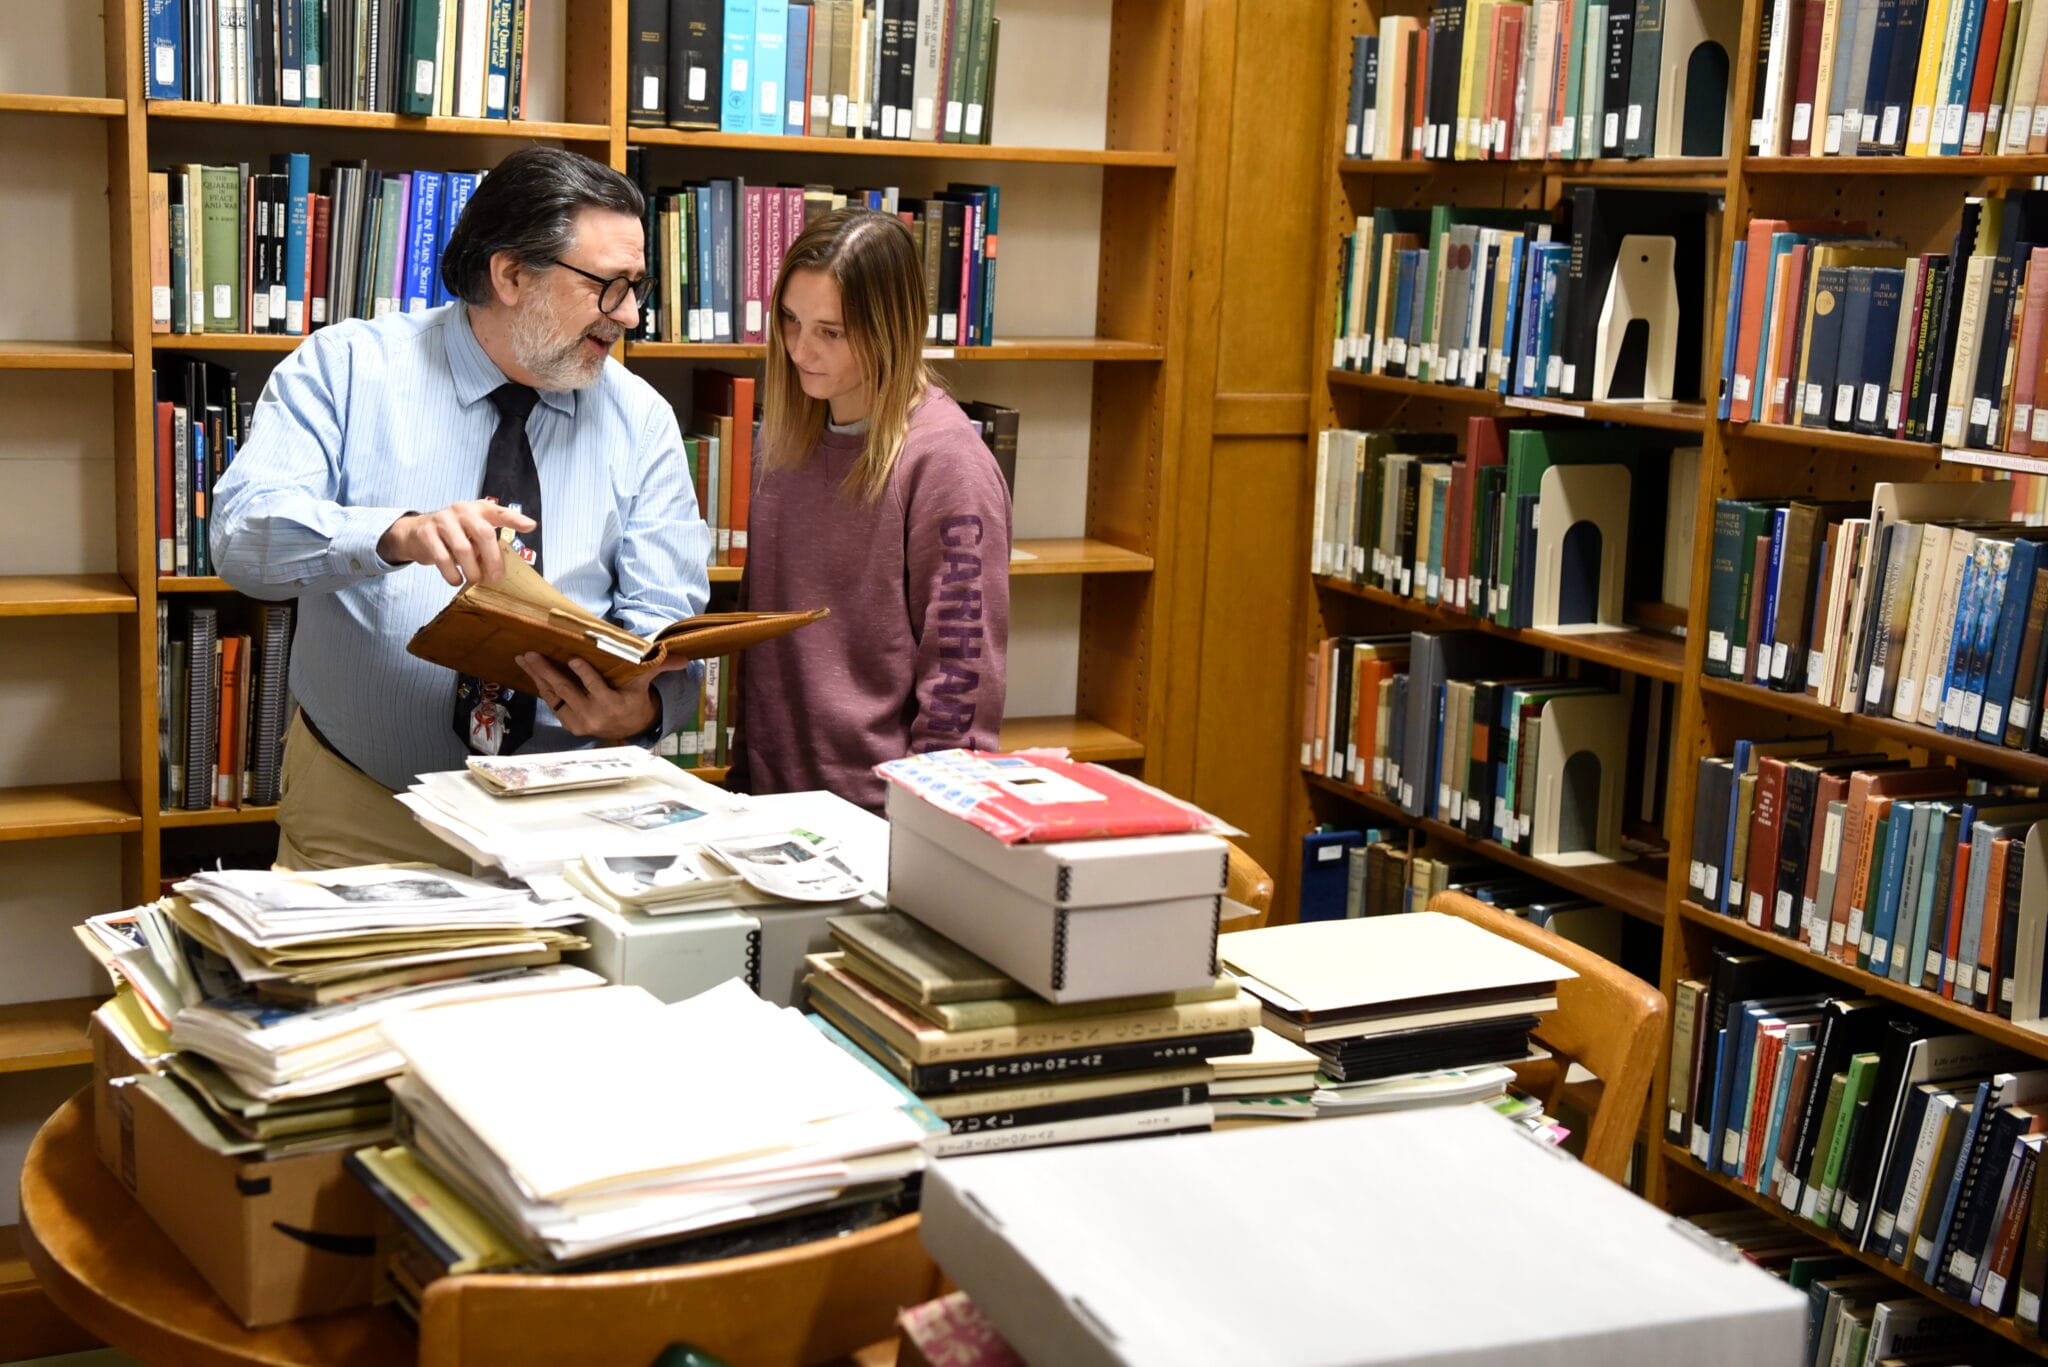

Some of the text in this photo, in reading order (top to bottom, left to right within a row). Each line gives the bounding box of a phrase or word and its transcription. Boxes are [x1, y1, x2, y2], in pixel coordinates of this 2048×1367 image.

[495, 1, 512, 69] Early Quakers
[515, 29, 523, 54] LIGHT
[1963, 22, 1973, 45] Heart
[1956, 57, 1967, 81] Things
[424, 175, 439, 216] HIDDEN
[752, 193, 760, 209] WILT
[421, 232, 434, 264] PLAIN
[419, 267, 432, 296] SIGHT
[1926, 268, 1936, 298] ESSAYS
[1964, 273, 1982, 314] While
[1918, 309, 1930, 352] GRATITUDE
[1955, 343, 1972, 371] Day
[214, 417, 223, 452] Answering
[1919, 572, 1930, 605] Beautiful
[1878, 561, 1901, 664] JOHN WOOLMAN'S PATH
[929, 1013, 1230, 1060] WILMINGTON COLLEGE
[949, 1046, 1198, 1084] WILMINGTONIAN 1958
[1953, 1128, 1974, 1184] GENEALOGY
[1908, 1168, 1922, 1190] God
